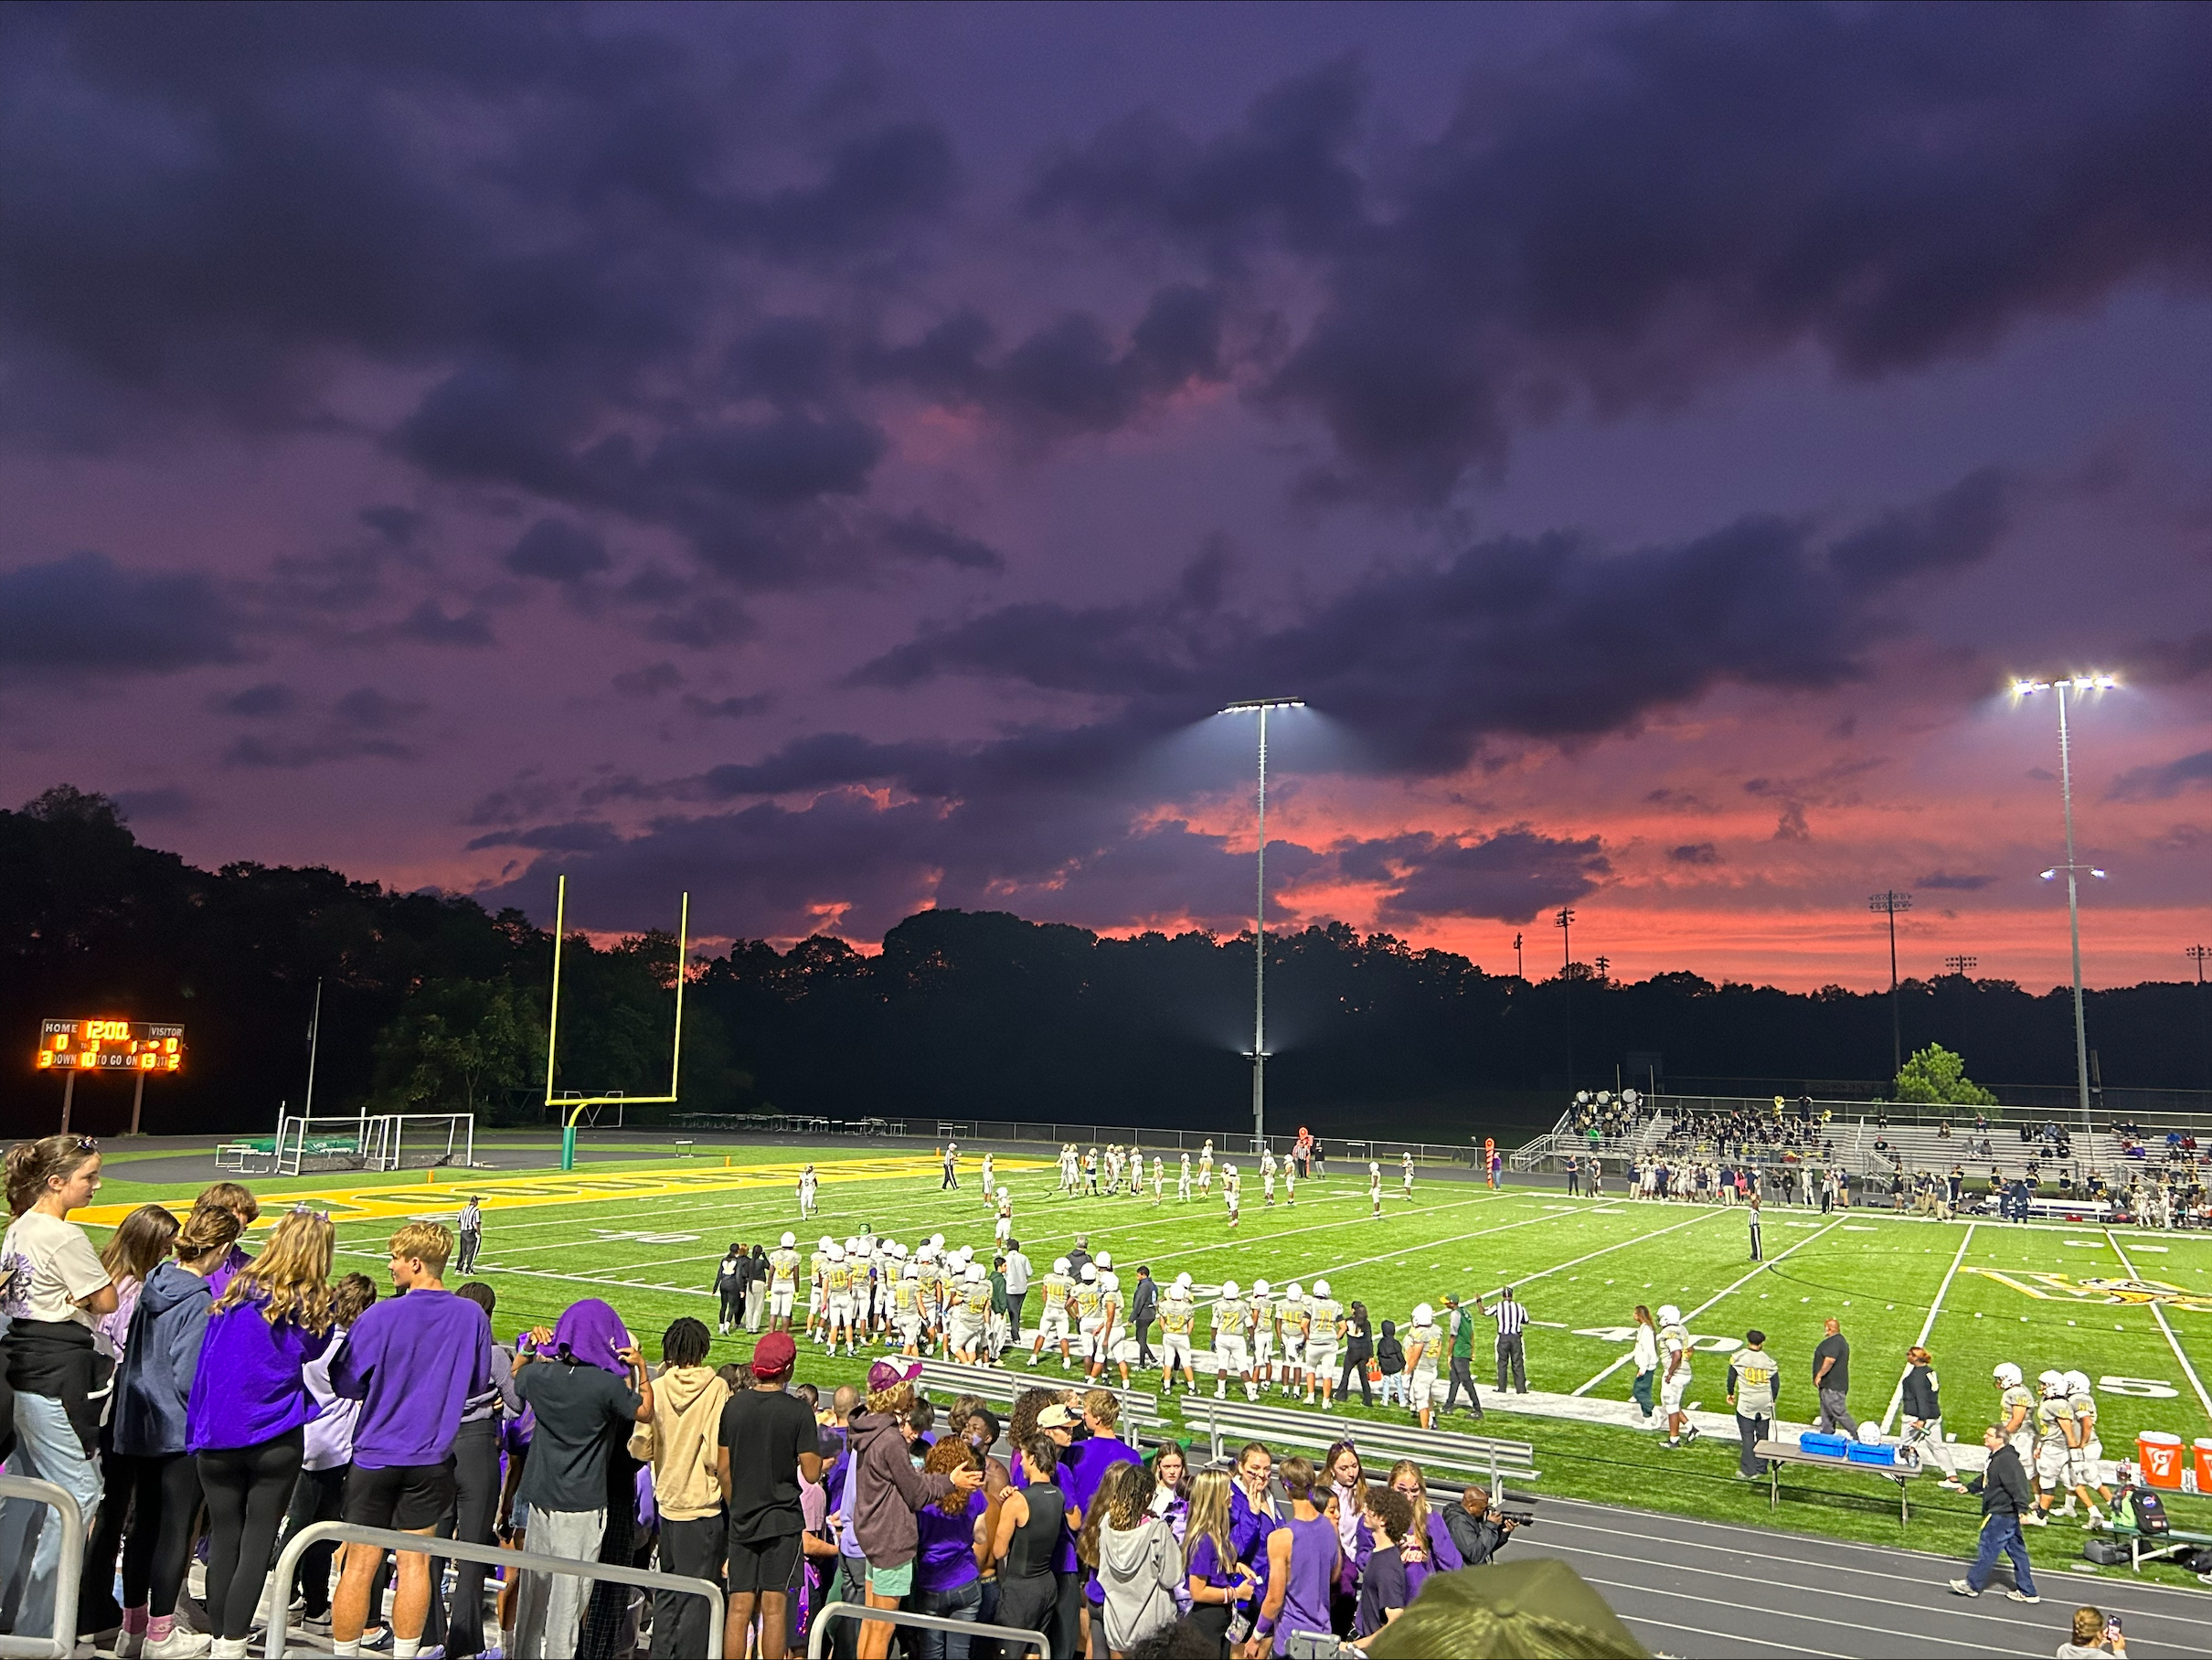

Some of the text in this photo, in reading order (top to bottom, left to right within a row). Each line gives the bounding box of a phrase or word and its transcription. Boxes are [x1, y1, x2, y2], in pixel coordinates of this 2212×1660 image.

[46, 1023, 78, 1033] HOME
[151, 1027, 182, 1037] VISITOR
[56, 1034, 69, 1050] 0
[90, 1040, 100, 1053] 3
[165, 1038, 178, 1053] 0
[40, 1050, 53, 1067] 3
[80, 1051, 97, 1067] 10
[110, 1055, 122, 1065] GO
[126, 1055, 138, 1066] ON
[168, 1054, 181, 1069] 2
[804, 1178, 809, 1186] 6
[830, 1269, 846, 1288] 10
[1166, 1314, 1185, 1334] 52
[1222, 1312, 1239, 1333] 77
[1317, 1310, 1333, 1331] 71
[2153, 1450, 2168, 1464] G
